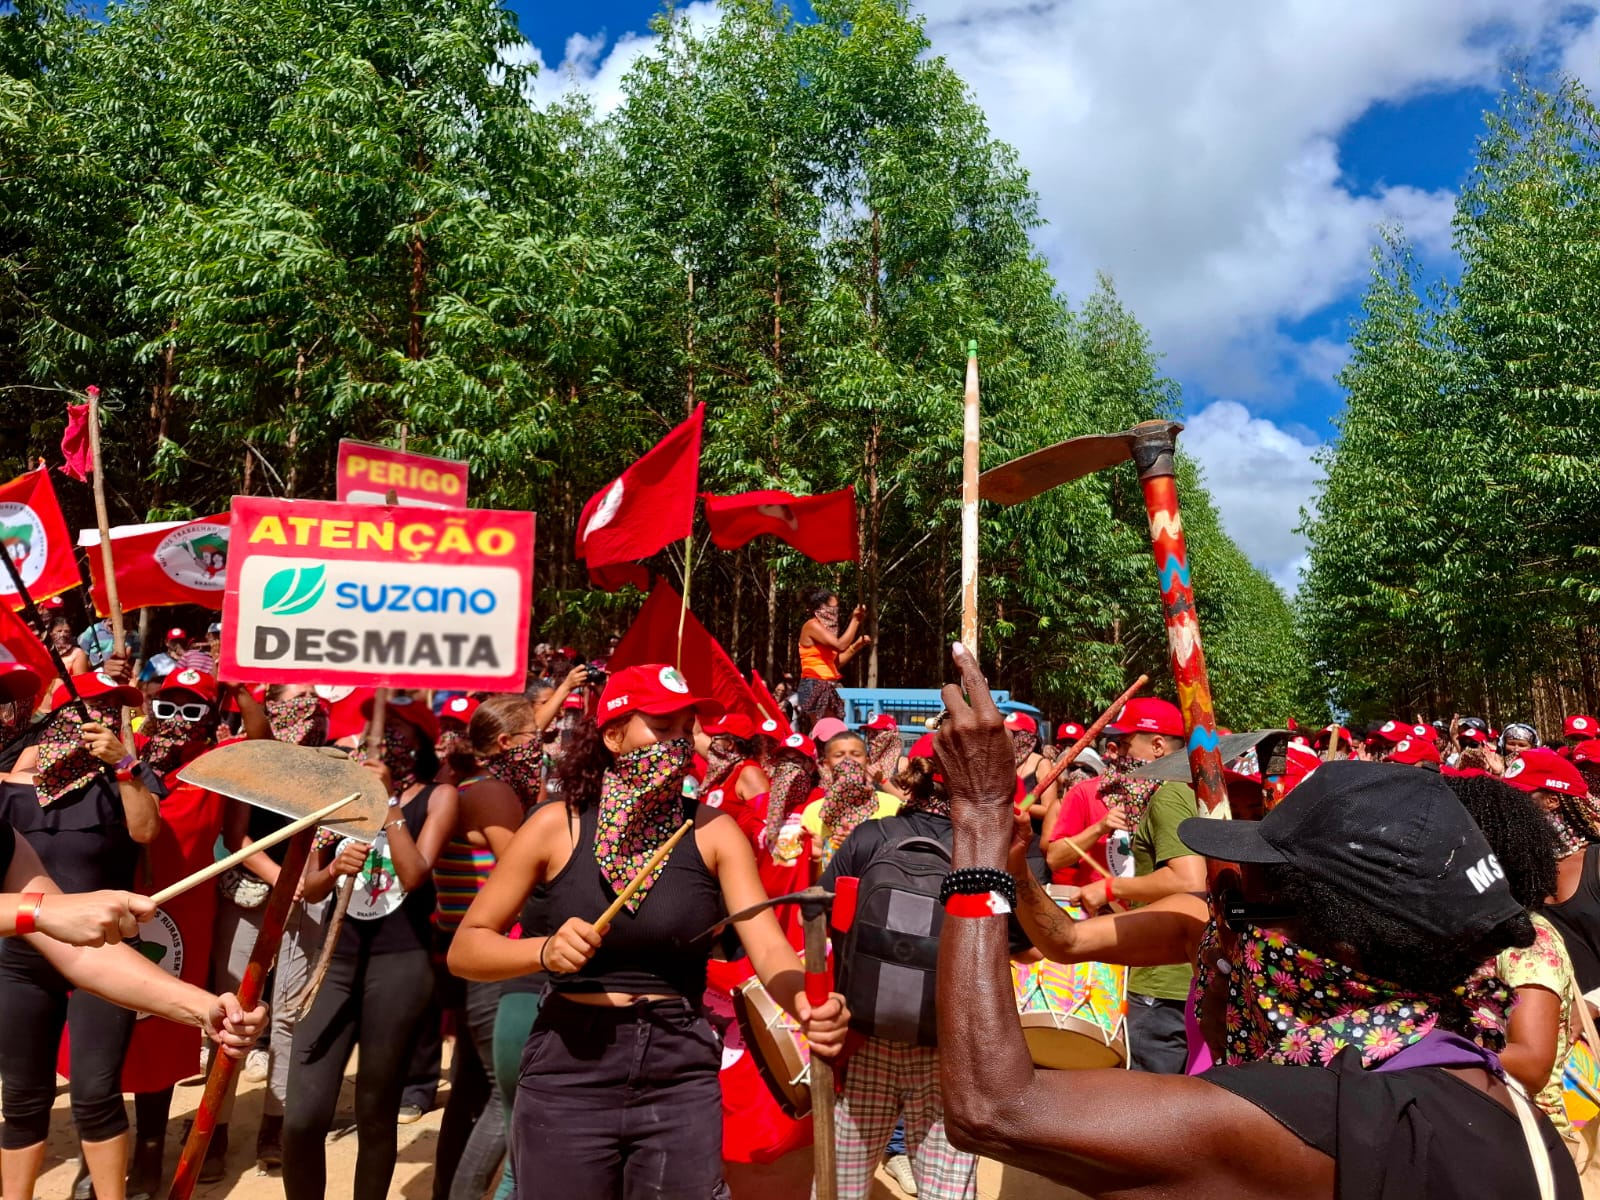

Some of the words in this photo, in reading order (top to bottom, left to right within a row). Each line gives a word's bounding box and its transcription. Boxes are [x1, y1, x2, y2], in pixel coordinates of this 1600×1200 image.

[345, 455, 461, 495] PERIGO
[248, 515, 516, 561] ATENÇÃO
[253, 625, 501, 669] DESMATA
[1545, 778, 1571, 790] MST
[160, 916, 182, 948] RURAIS
[173, 950, 182, 971] SEM
